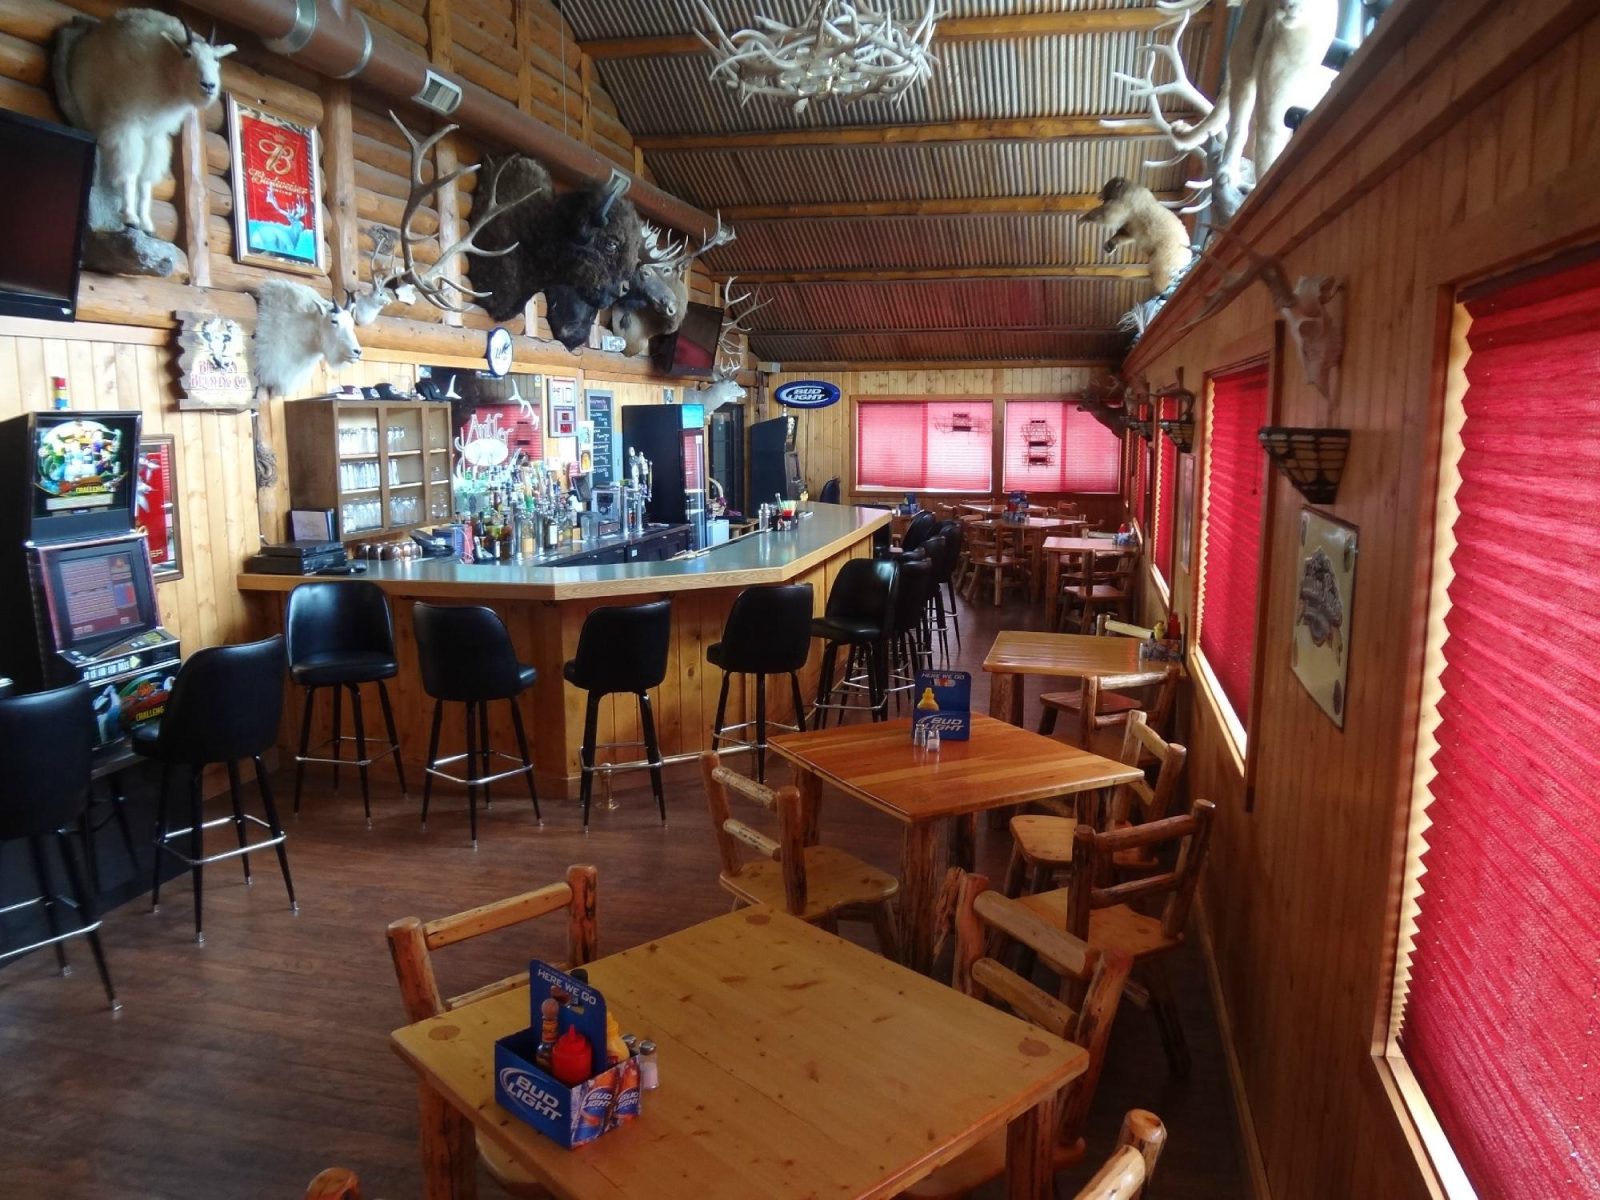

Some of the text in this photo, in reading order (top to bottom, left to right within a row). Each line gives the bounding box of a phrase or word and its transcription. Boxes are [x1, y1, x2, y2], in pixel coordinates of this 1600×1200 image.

[248, 168, 308, 194] Budweiser
[136, 706, 164, 721] CHALLENG
[930, 717, 962, 725] BUD
[923, 723, 965, 731] LIGHT
[537, 968, 597, 1005] HERE WE GO
[507, 1082, 562, 1121] LIGHT
[515, 1075, 560, 1109] BUD
[588, 1092, 613, 1100] BUD
